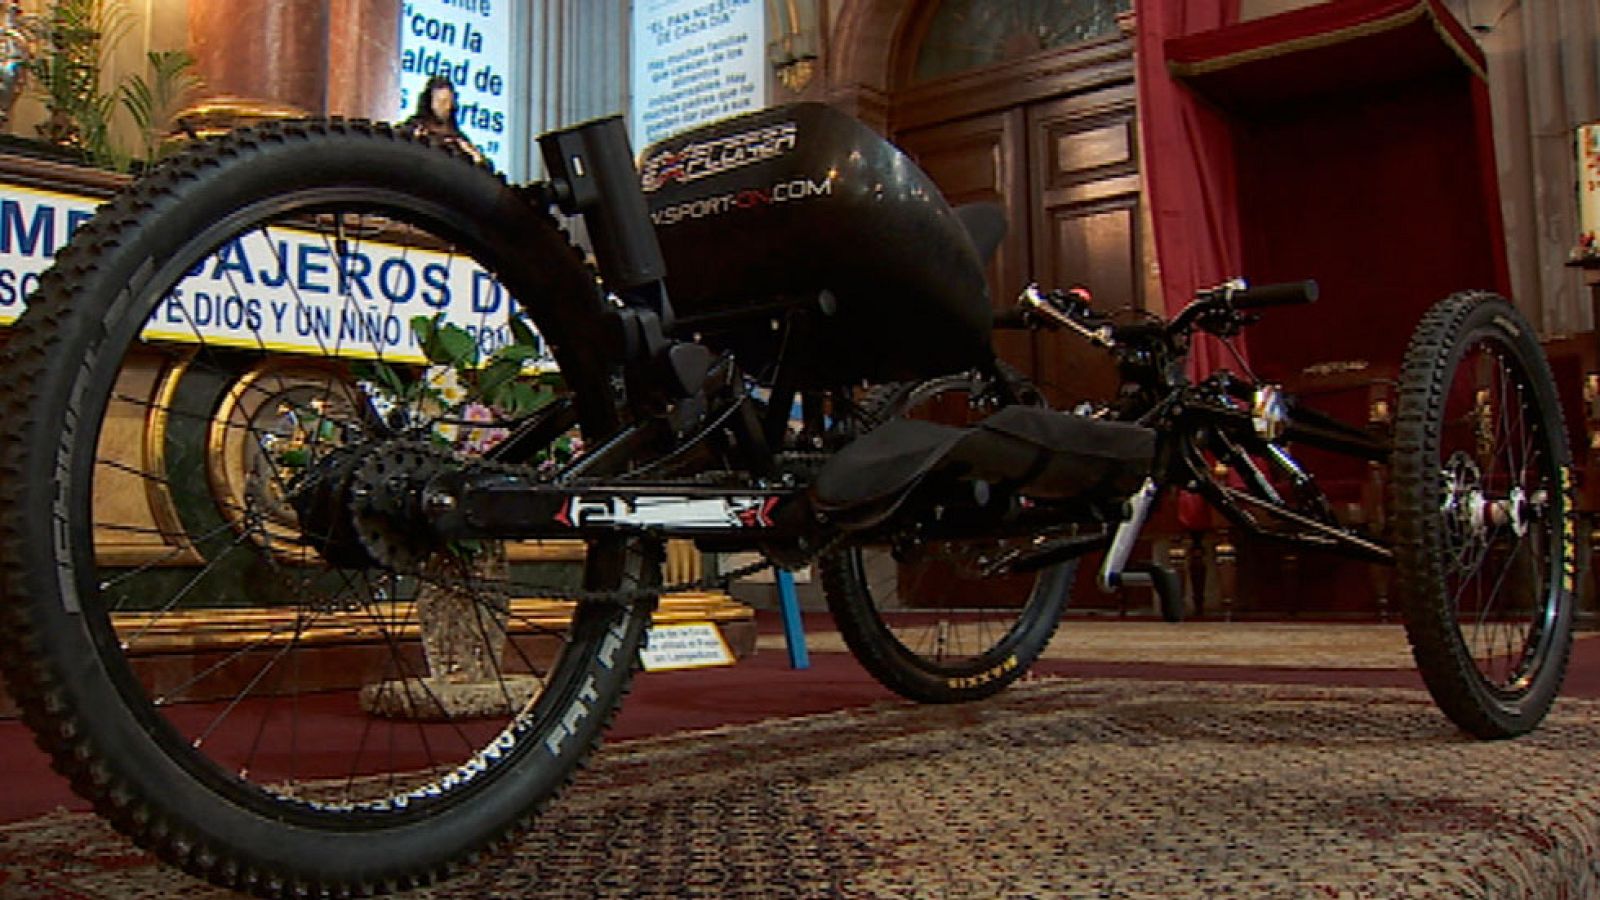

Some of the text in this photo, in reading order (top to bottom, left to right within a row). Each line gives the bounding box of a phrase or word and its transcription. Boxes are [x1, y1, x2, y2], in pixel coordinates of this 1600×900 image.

[462, 22, 483, 53] la
[474, 65, 503, 96] de
[194, 291, 262, 331] DIOS
[271, 301, 287, 333] Y
[295, 304, 331, 338] UN
[340, 306, 401, 346] NIÑO
[545, 674, 599, 757] FAT
